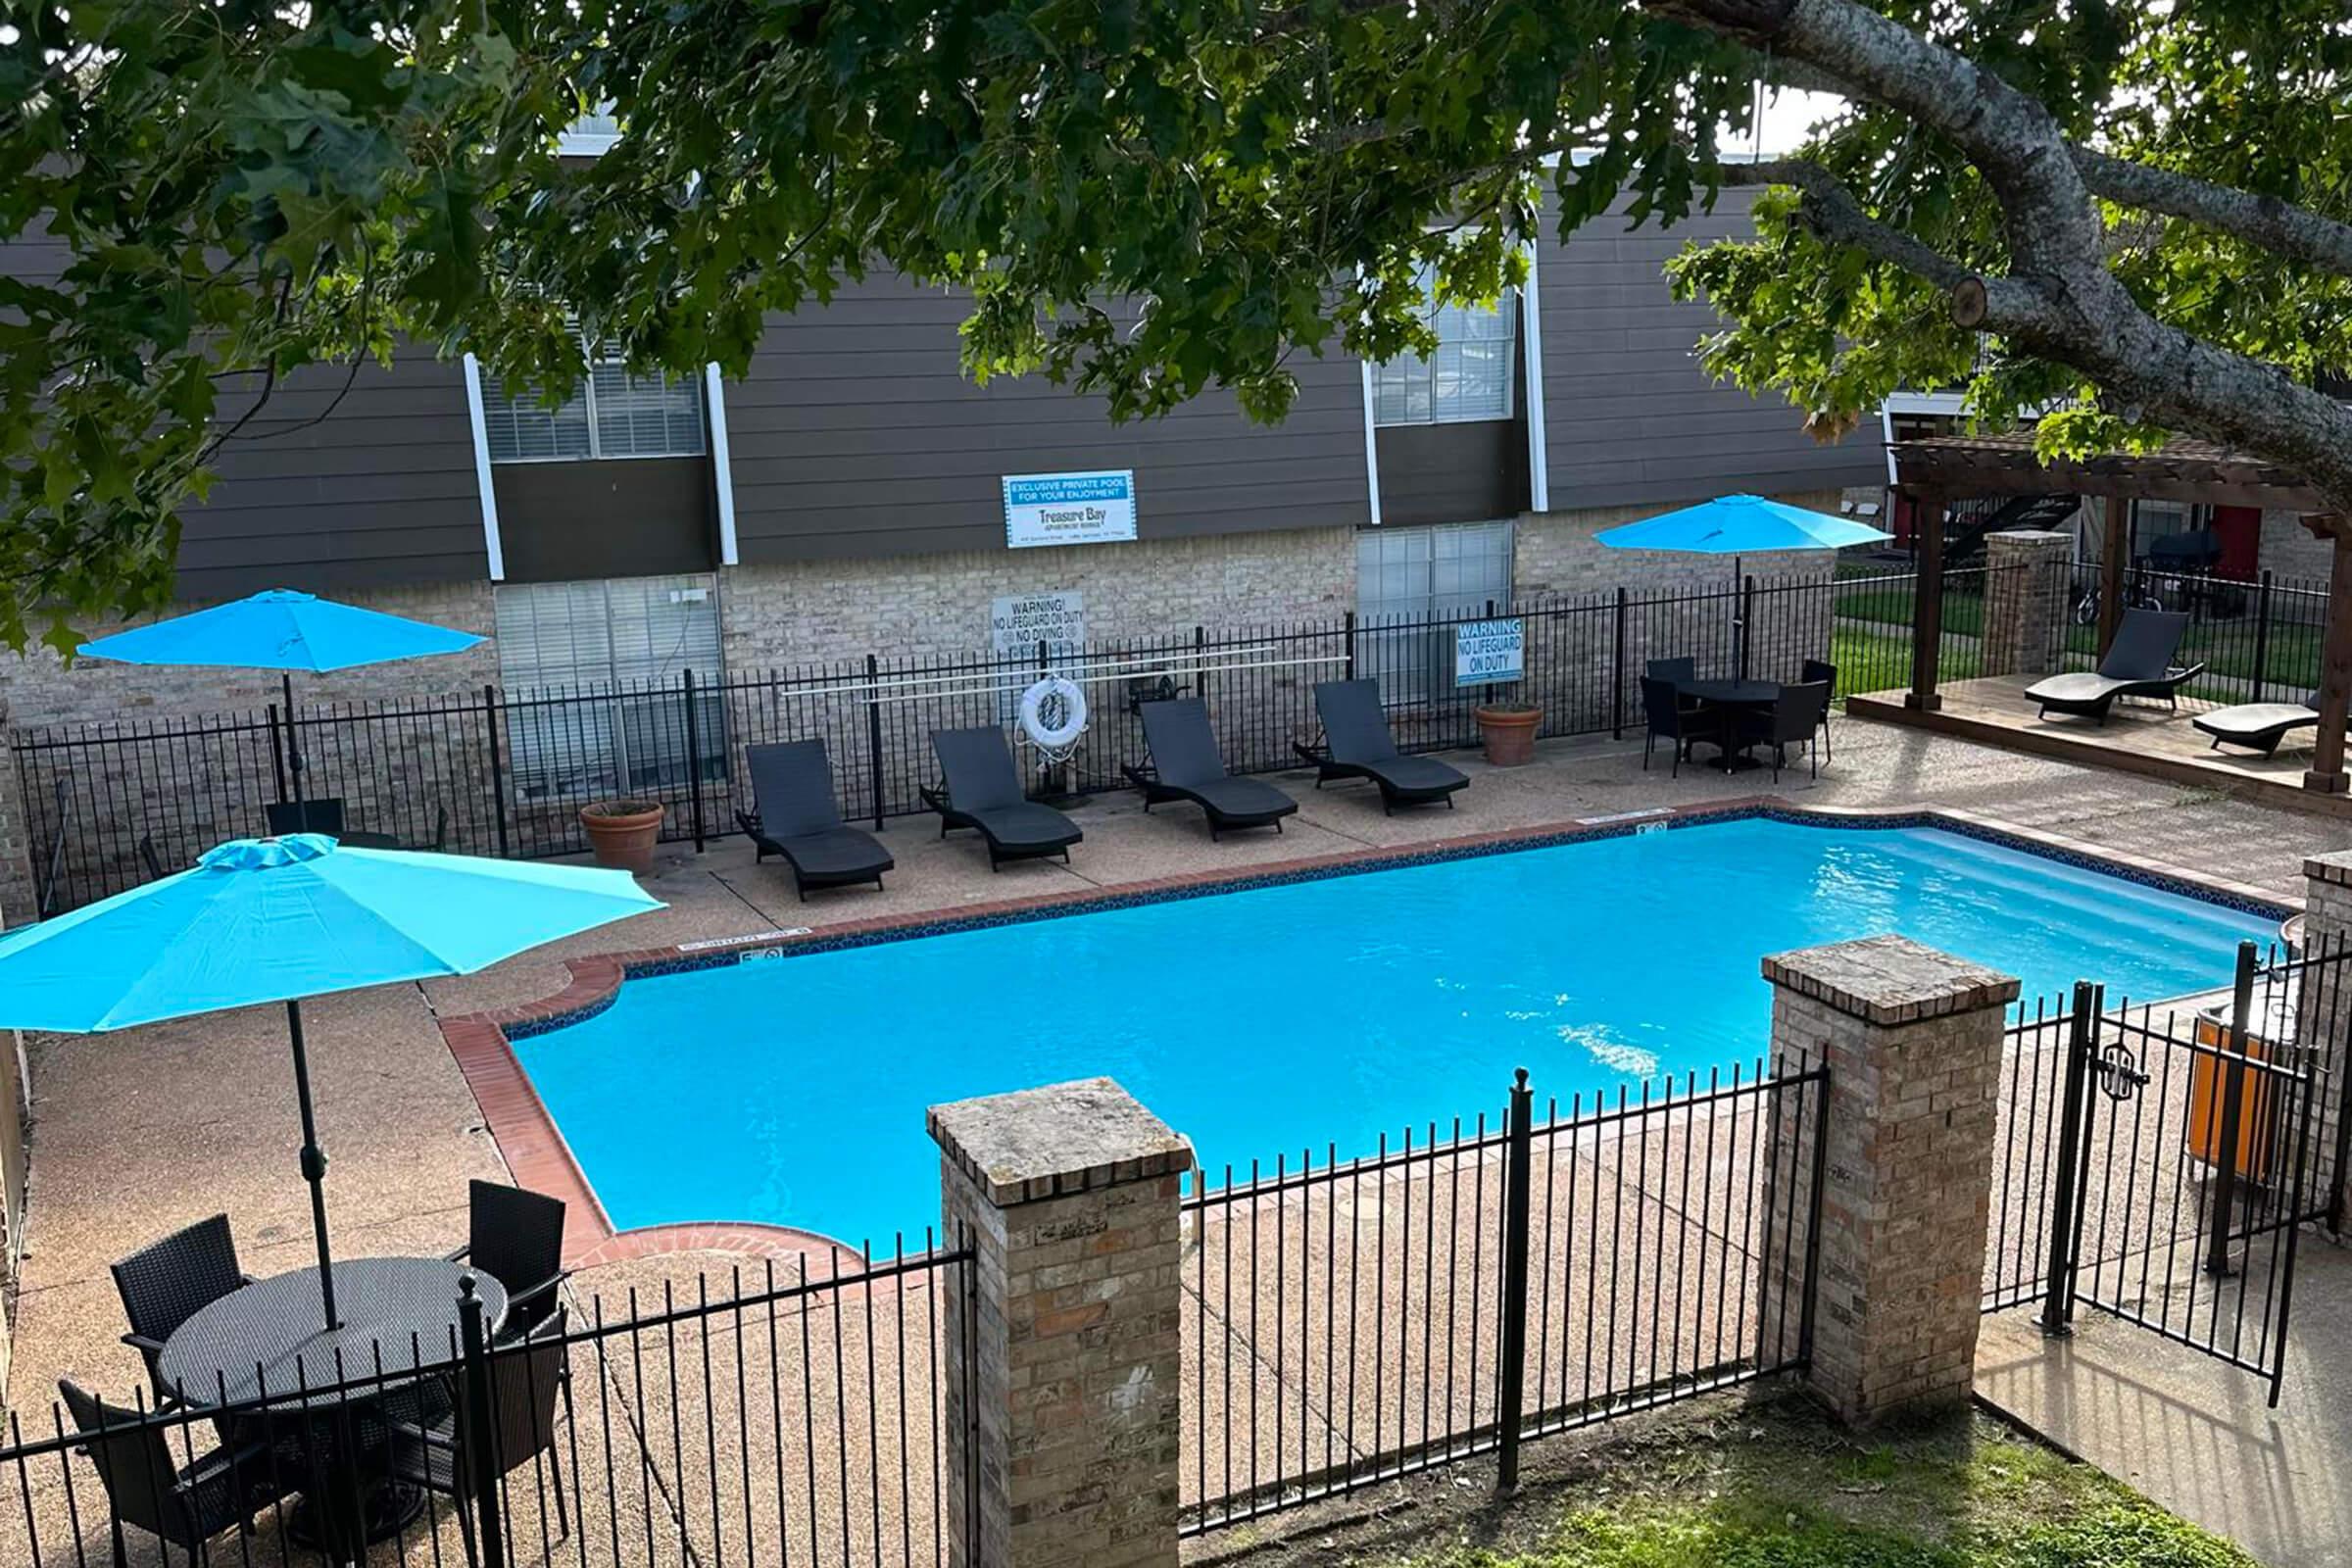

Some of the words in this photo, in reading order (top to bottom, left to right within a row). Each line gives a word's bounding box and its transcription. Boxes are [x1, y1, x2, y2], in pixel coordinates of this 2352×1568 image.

[1011, 482, 1060, 493] EXCLUSIVE
[1061, 480, 1099, 490] PRIVATE
[1101, 478, 1126, 488] POOL
[1019, 492, 1039, 502] FOR
[1041, 490, 1065, 501] YOUR
[1066, 488, 1120, 499] ENJOYMENT
[1039, 509, 1085, 523] Treasure
[1085, 507, 1106, 525] Bay
[994, 616, 1005, 630] NO
[1006, 612, 1051, 629] LIFEGUARD
[1051, 612, 1063, 625] ON
[1063, 611, 1083, 624] DUTY
[1458, 618, 1522, 638] WARNING
[1016, 629, 1031, 643] NO
[1032, 625, 1064, 641] DIVING
[1458, 640, 1472, 656] NO
[1472, 635, 1522, 655] LIFEGUARD
[1470, 657, 1484, 673] ON
[1484, 655, 1509, 670] DUTY
